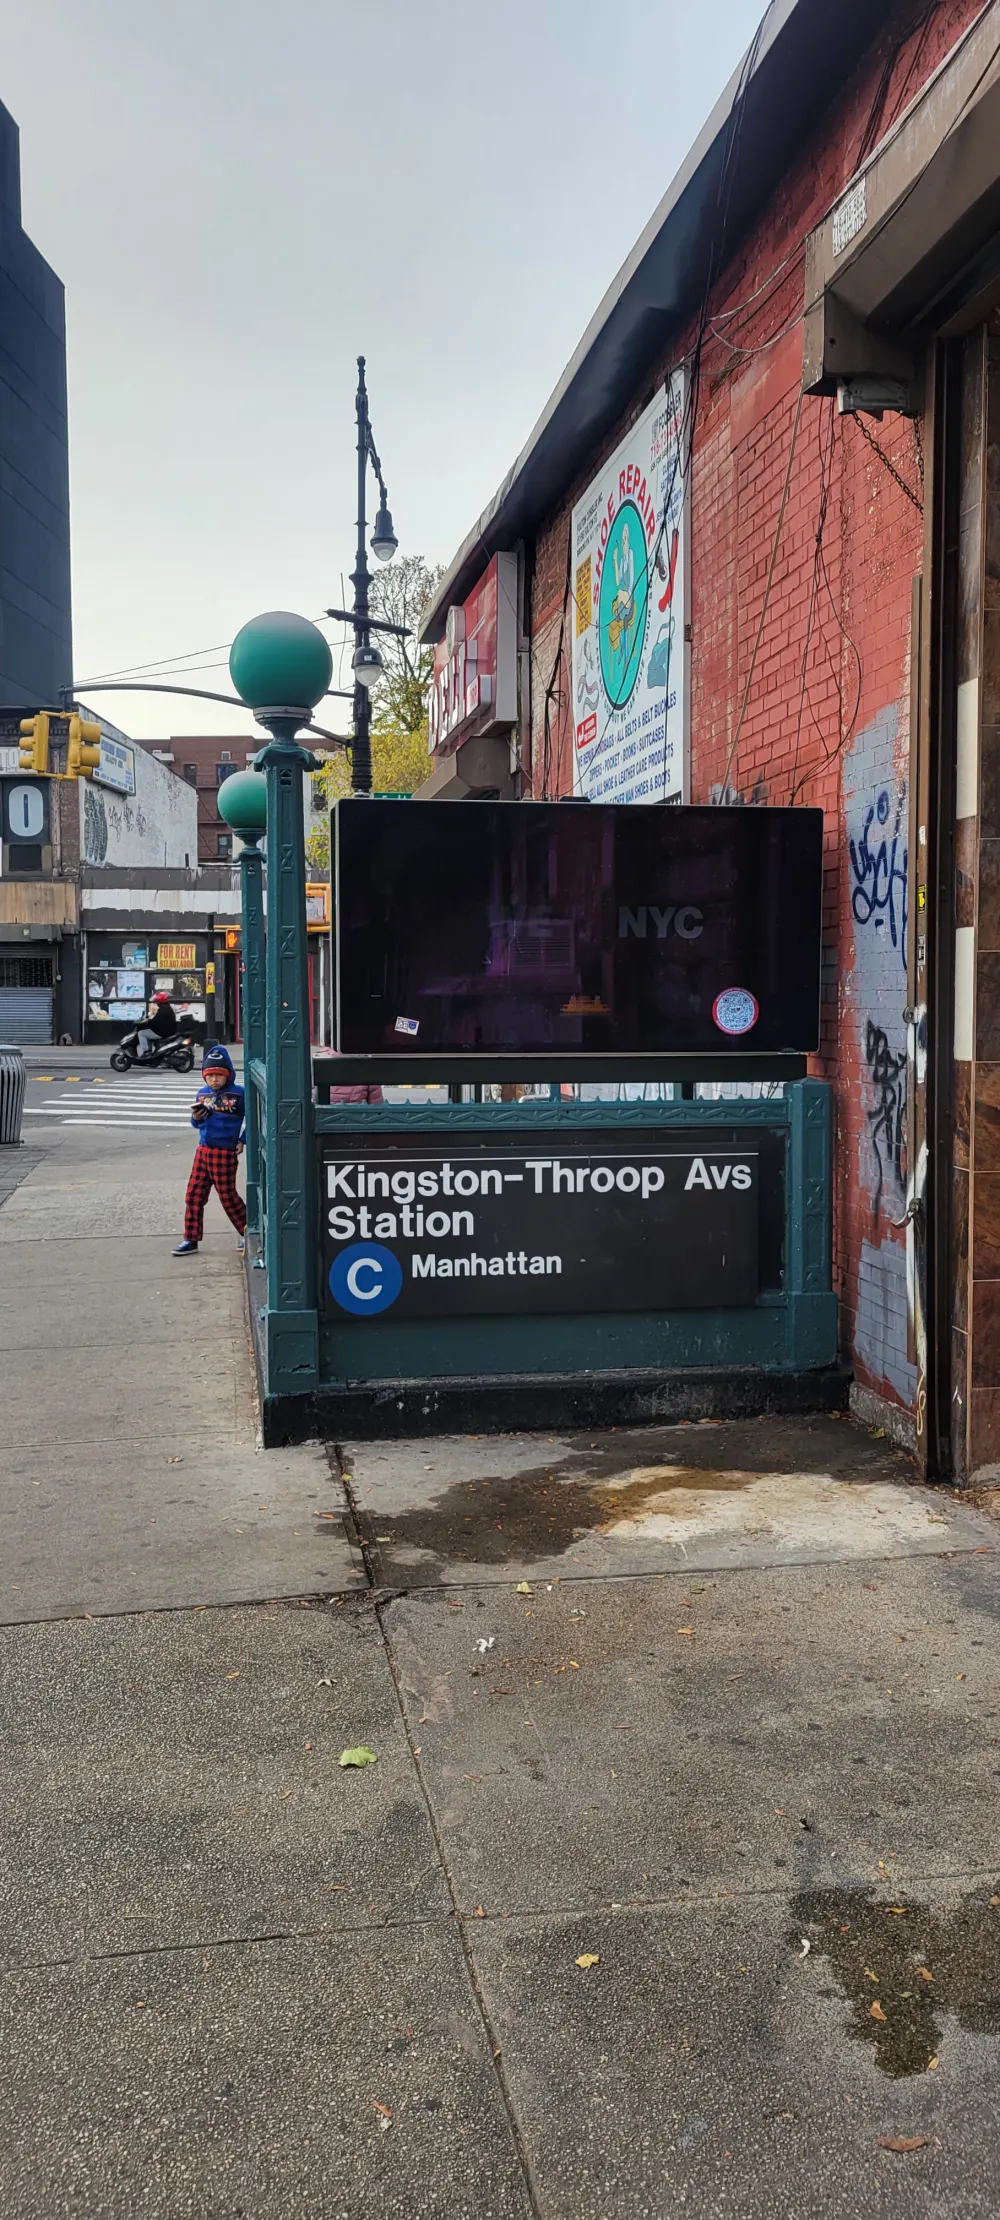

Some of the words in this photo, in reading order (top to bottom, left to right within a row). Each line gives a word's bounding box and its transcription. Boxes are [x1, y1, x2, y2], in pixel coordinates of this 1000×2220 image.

[593, 492, 616, 607] SHOE
[619, 463, 656, 546] REPAIR
[616, 730, 625, 744] ALL
[625, 719, 637, 738] BELTS
[642, 707, 653, 726] BELT
[603, 776, 614, 794] SHOE
[618, 764, 635, 786] LEATHER
[636, 757, 647, 776] CARE
[648, 742, 674, 769] PRODUCTS
[604, 752, 620, 773] POCKET
[622, 742, 636, 762] BOOKS
[639, 725, 664, 752] SUITCASES
[634, 778, 649, 800] SHOES
[618, 906, 704, 939] NYC
[160, 945, 174, 959] FOR
[175, 945, 194, 959] RENT
[327, 1160, 664, 1204] Kingston-Throop
[684, 1158, 752, 1191] Avs
[328, 1205, 474, 1240] Station
[346, 1258, 383, 1300] C
[411, 1252, 562, 1278] Manhattan
